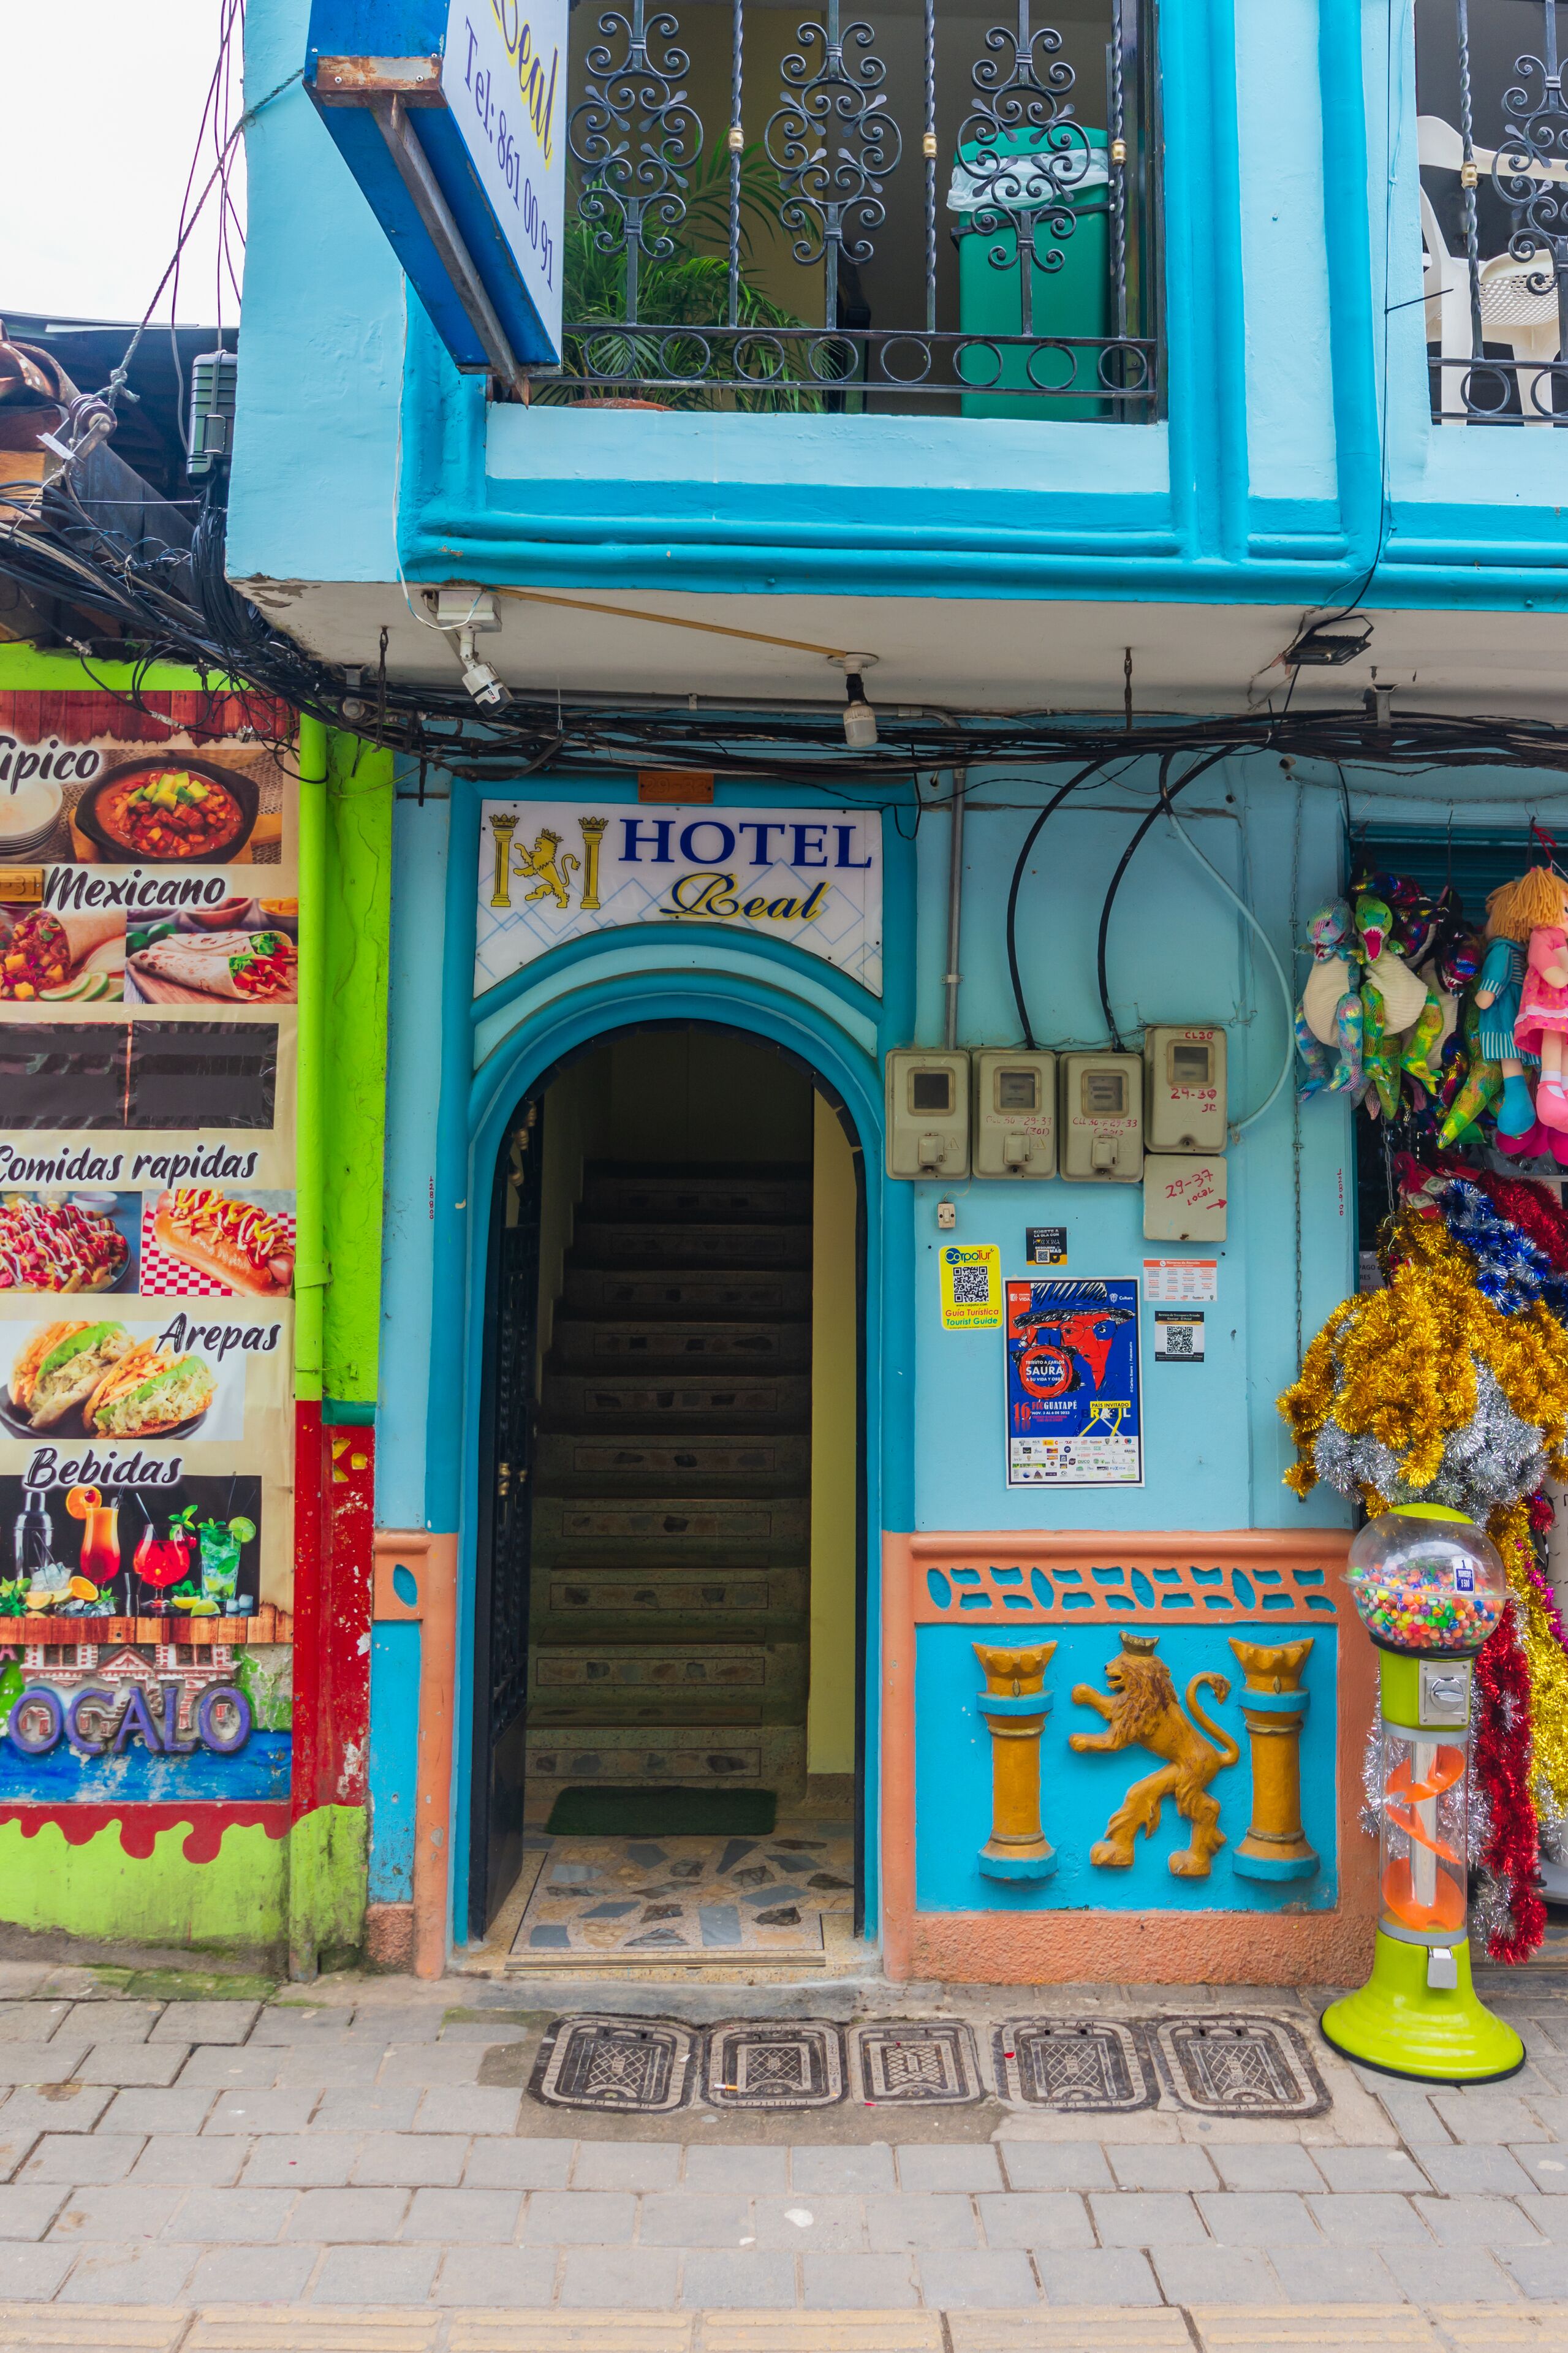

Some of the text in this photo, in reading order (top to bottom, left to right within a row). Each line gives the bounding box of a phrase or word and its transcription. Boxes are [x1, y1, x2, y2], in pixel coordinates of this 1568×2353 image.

[464, 15, 553, 293] Tel: 861 00 91
[618, 818, 872, 868] HOTEL
[44, 866, 226, 911] Mexicano
[659, 872, 830, 921] Real
[0, 1144, 259, 1189] Comidas rapidas
[1165, 1169, 1213, 1199] 29-37
[156, 1313, 282, 1362] Arepas
[1026, 1366, 1064, 1375] SAURA
[1013, 1402, 1031, 1419] 16
[24, 1447, 183, 1488] Bebidas
